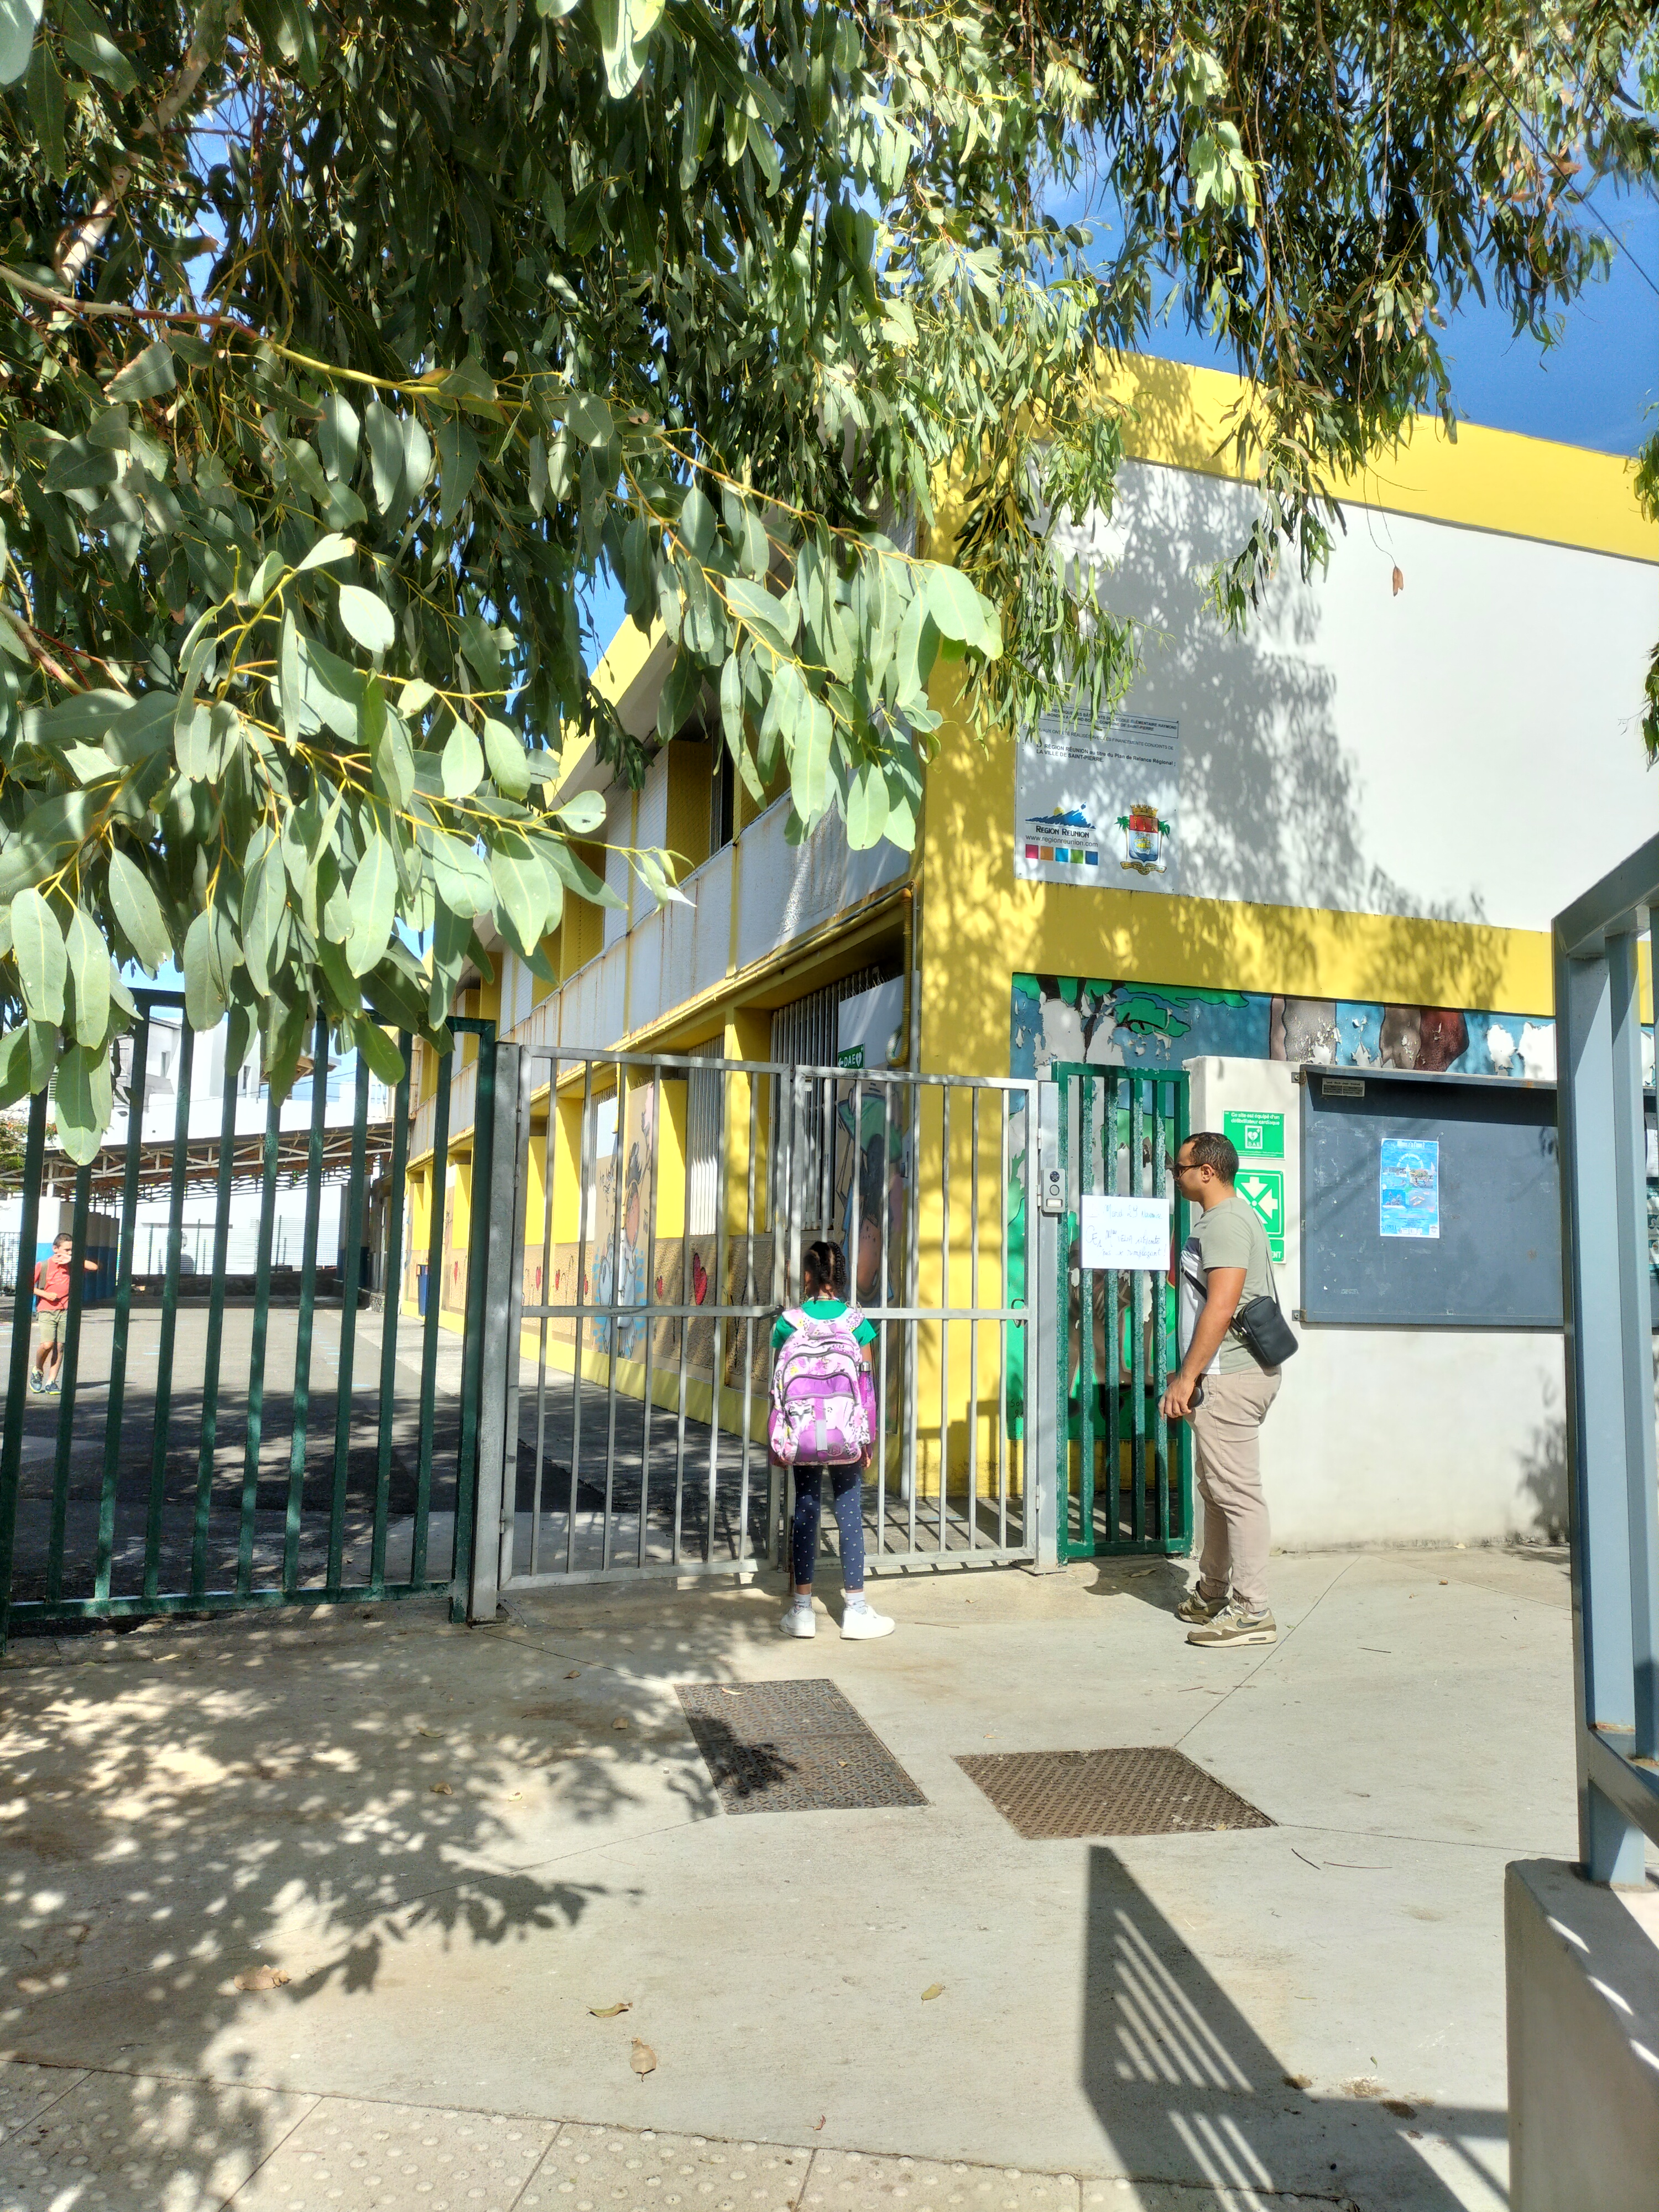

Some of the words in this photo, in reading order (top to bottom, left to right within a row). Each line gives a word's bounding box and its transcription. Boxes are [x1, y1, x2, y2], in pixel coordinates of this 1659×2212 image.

[1131, 718, 1158, 727] ÉLÉMENTAIRE
[1112, 738, 1144, 746] FINANCEMENTS
[1065, 745, 1089, 754] RÉUNION
[1025, 834, 1098, 848] www.regionreunion.com
[844, 1053, 855, 1067] DAE
